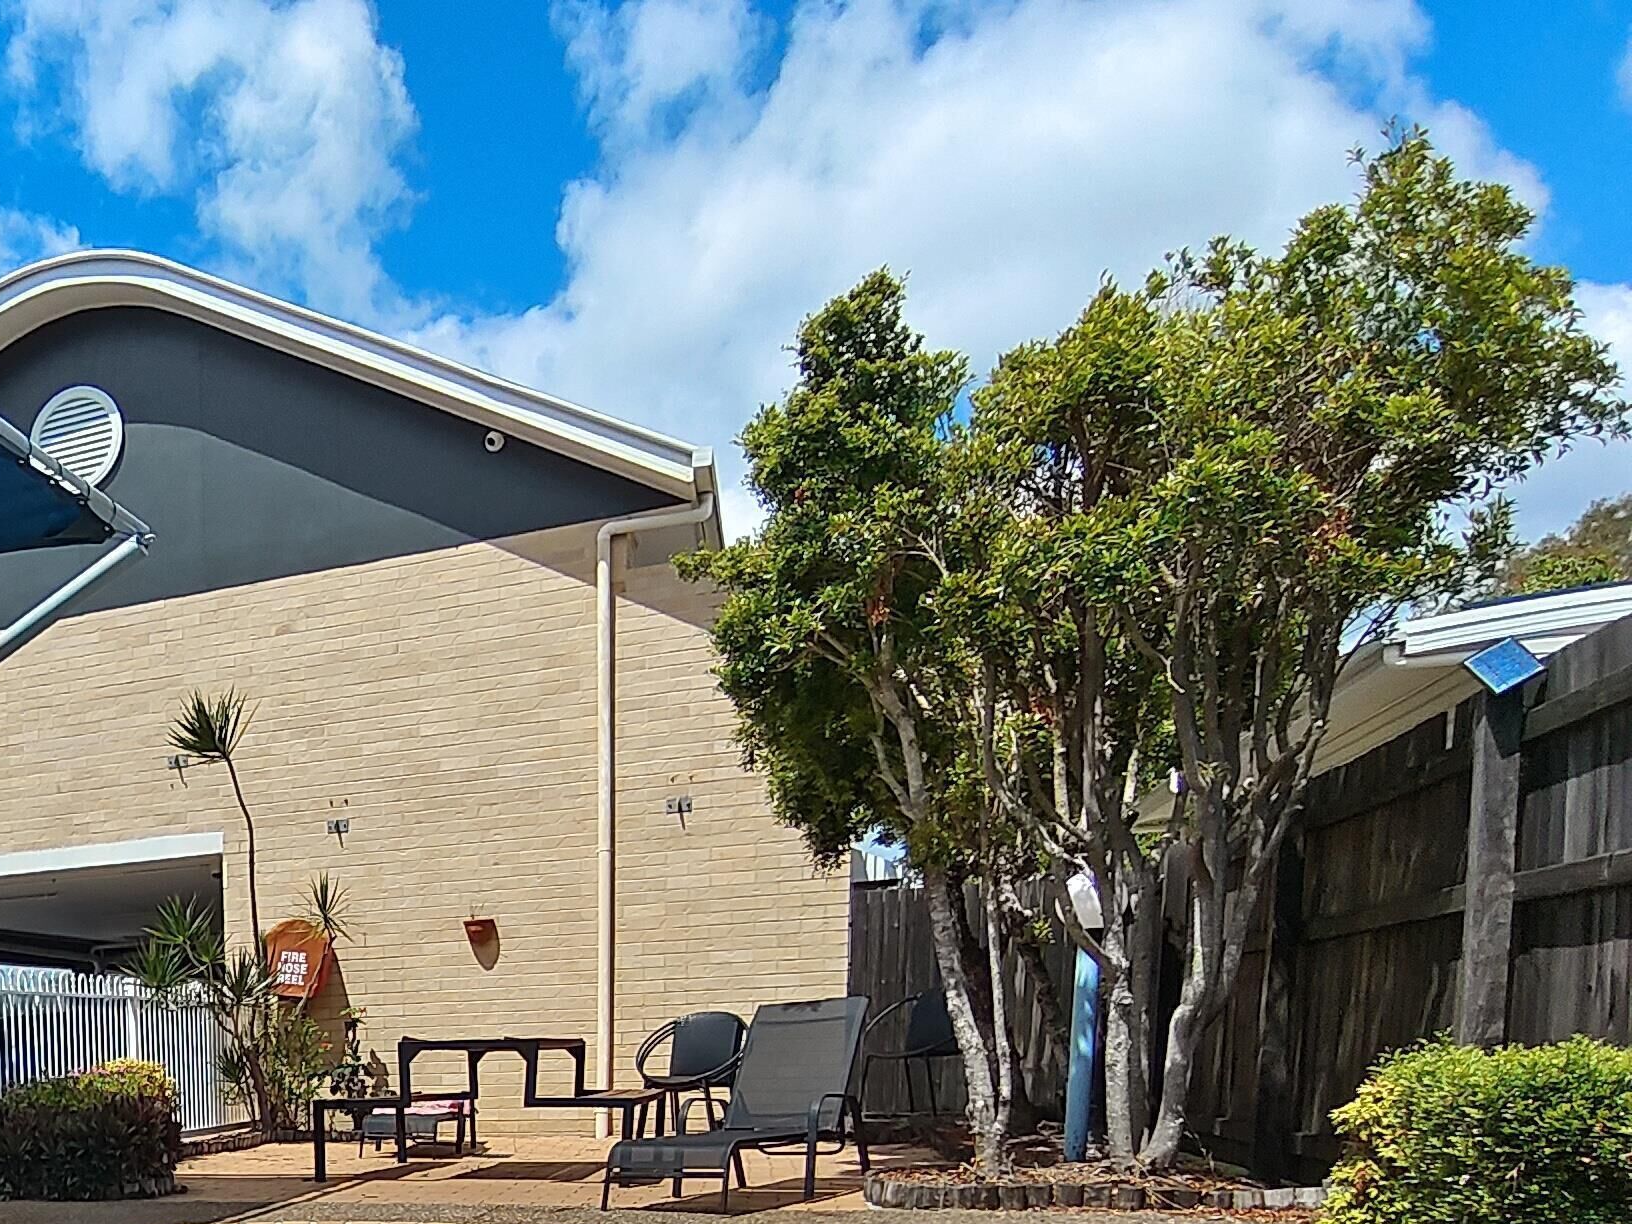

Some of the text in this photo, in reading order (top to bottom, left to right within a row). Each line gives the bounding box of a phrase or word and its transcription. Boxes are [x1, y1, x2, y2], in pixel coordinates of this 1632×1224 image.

[281, 951, 307, 963] FIRE
[277, 962, 308, 974] HOSE
[276, 974, 305, 985] REEL
